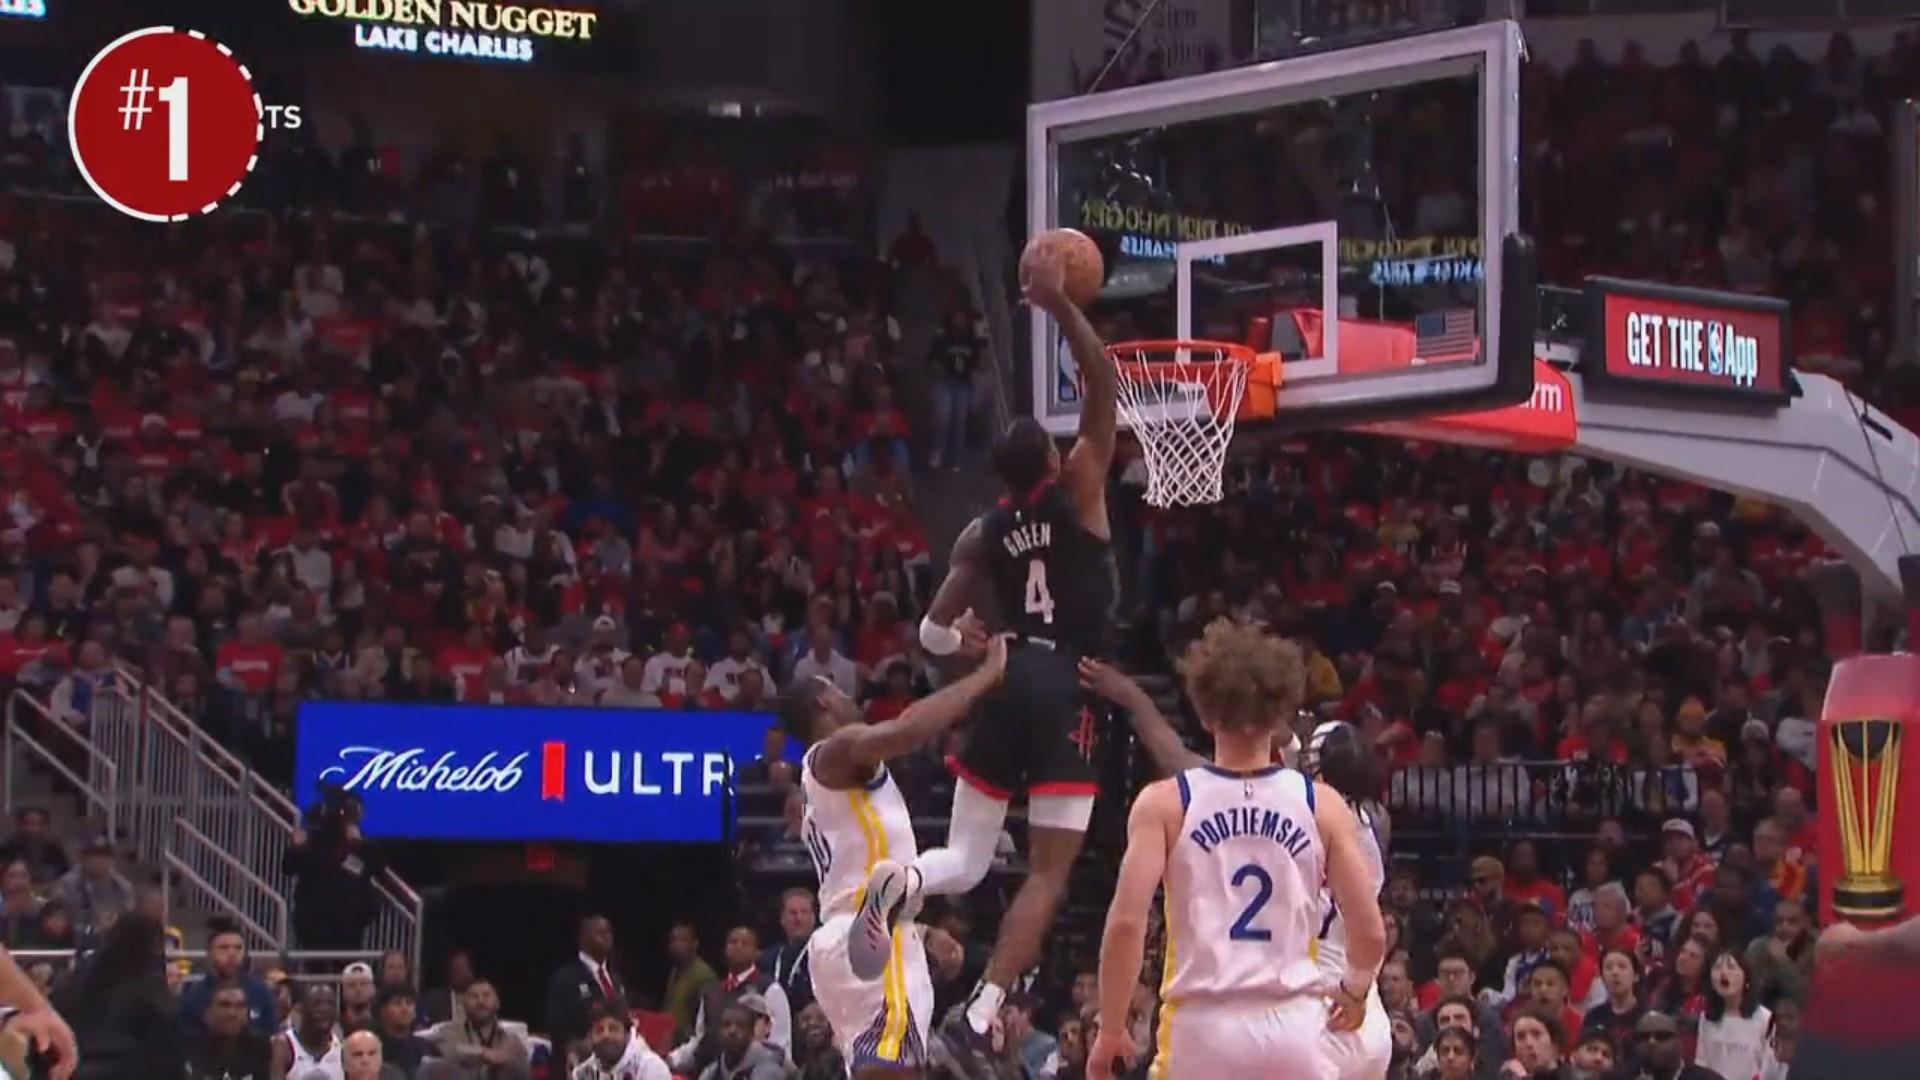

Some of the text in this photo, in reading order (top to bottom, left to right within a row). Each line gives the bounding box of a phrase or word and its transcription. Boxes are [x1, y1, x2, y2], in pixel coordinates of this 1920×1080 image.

[289, 0, 596, 39] GOLDEN NUGGET
[355, 23, 533, 61] LAKE CHARLES
[1627, 311, 1758, 386] GET THE App
[1524, 383, 1562, 412] rm
[1003, 522, 1051, 557] GREEN
[1025, 559, 1055, 624] 4
[320, 747, 762, 796] Michelob ULTR
[1190, 806, 1311, 858] PODZIEMSKI
[1230, 864, 1273, 941] 2
